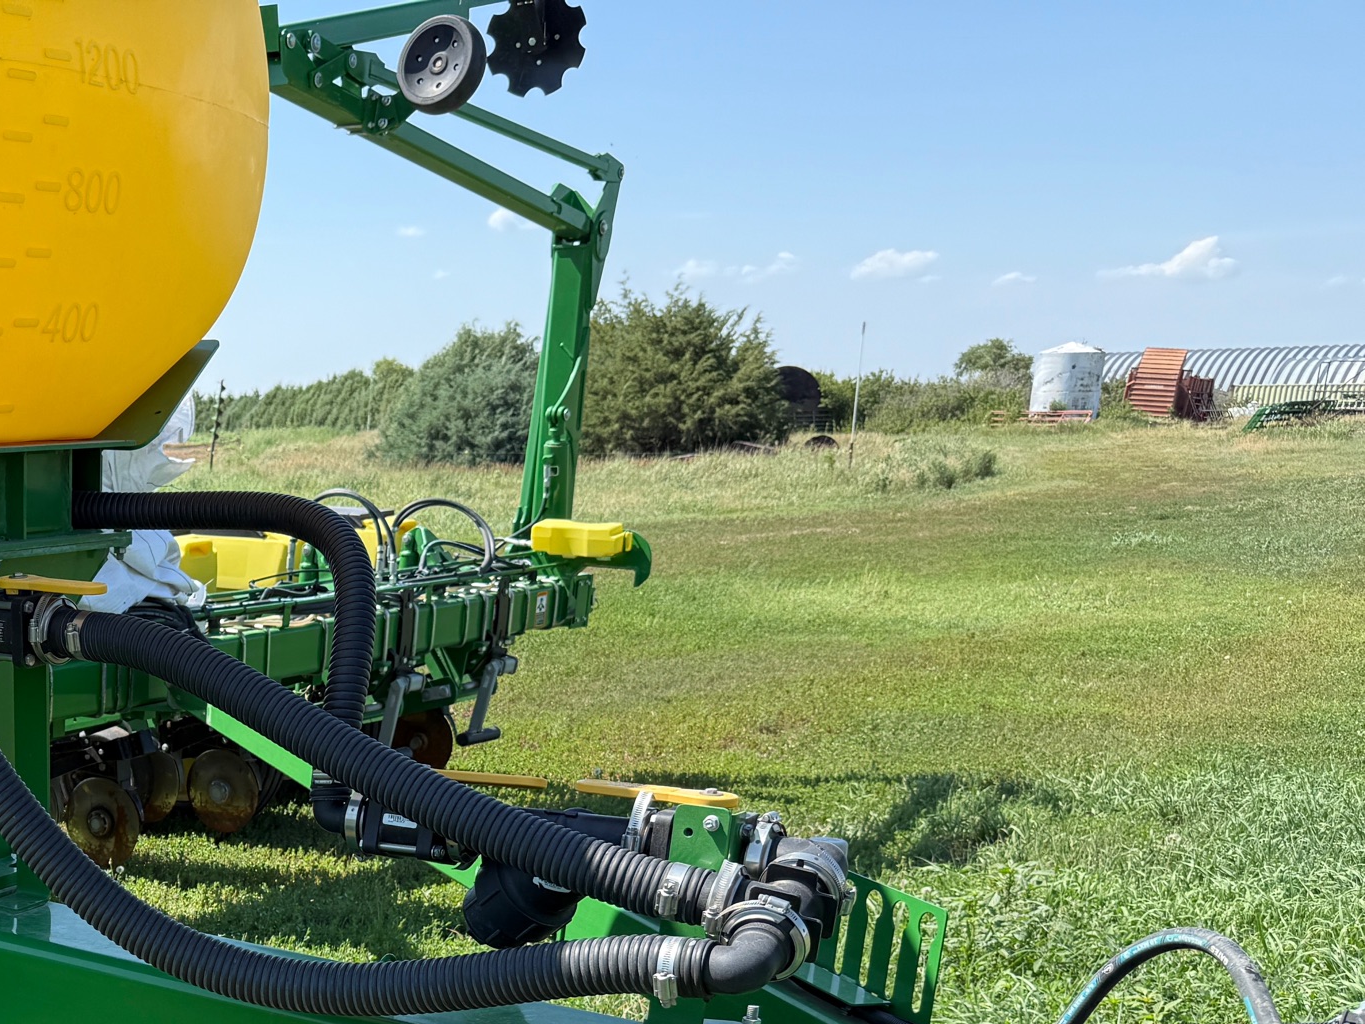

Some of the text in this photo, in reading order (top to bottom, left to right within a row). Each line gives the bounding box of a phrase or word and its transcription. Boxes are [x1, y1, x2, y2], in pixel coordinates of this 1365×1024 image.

[74, 38, 139, 95] 1200
[65, 167, 121, 215] 800
[41, 302, 99, 343] 400
